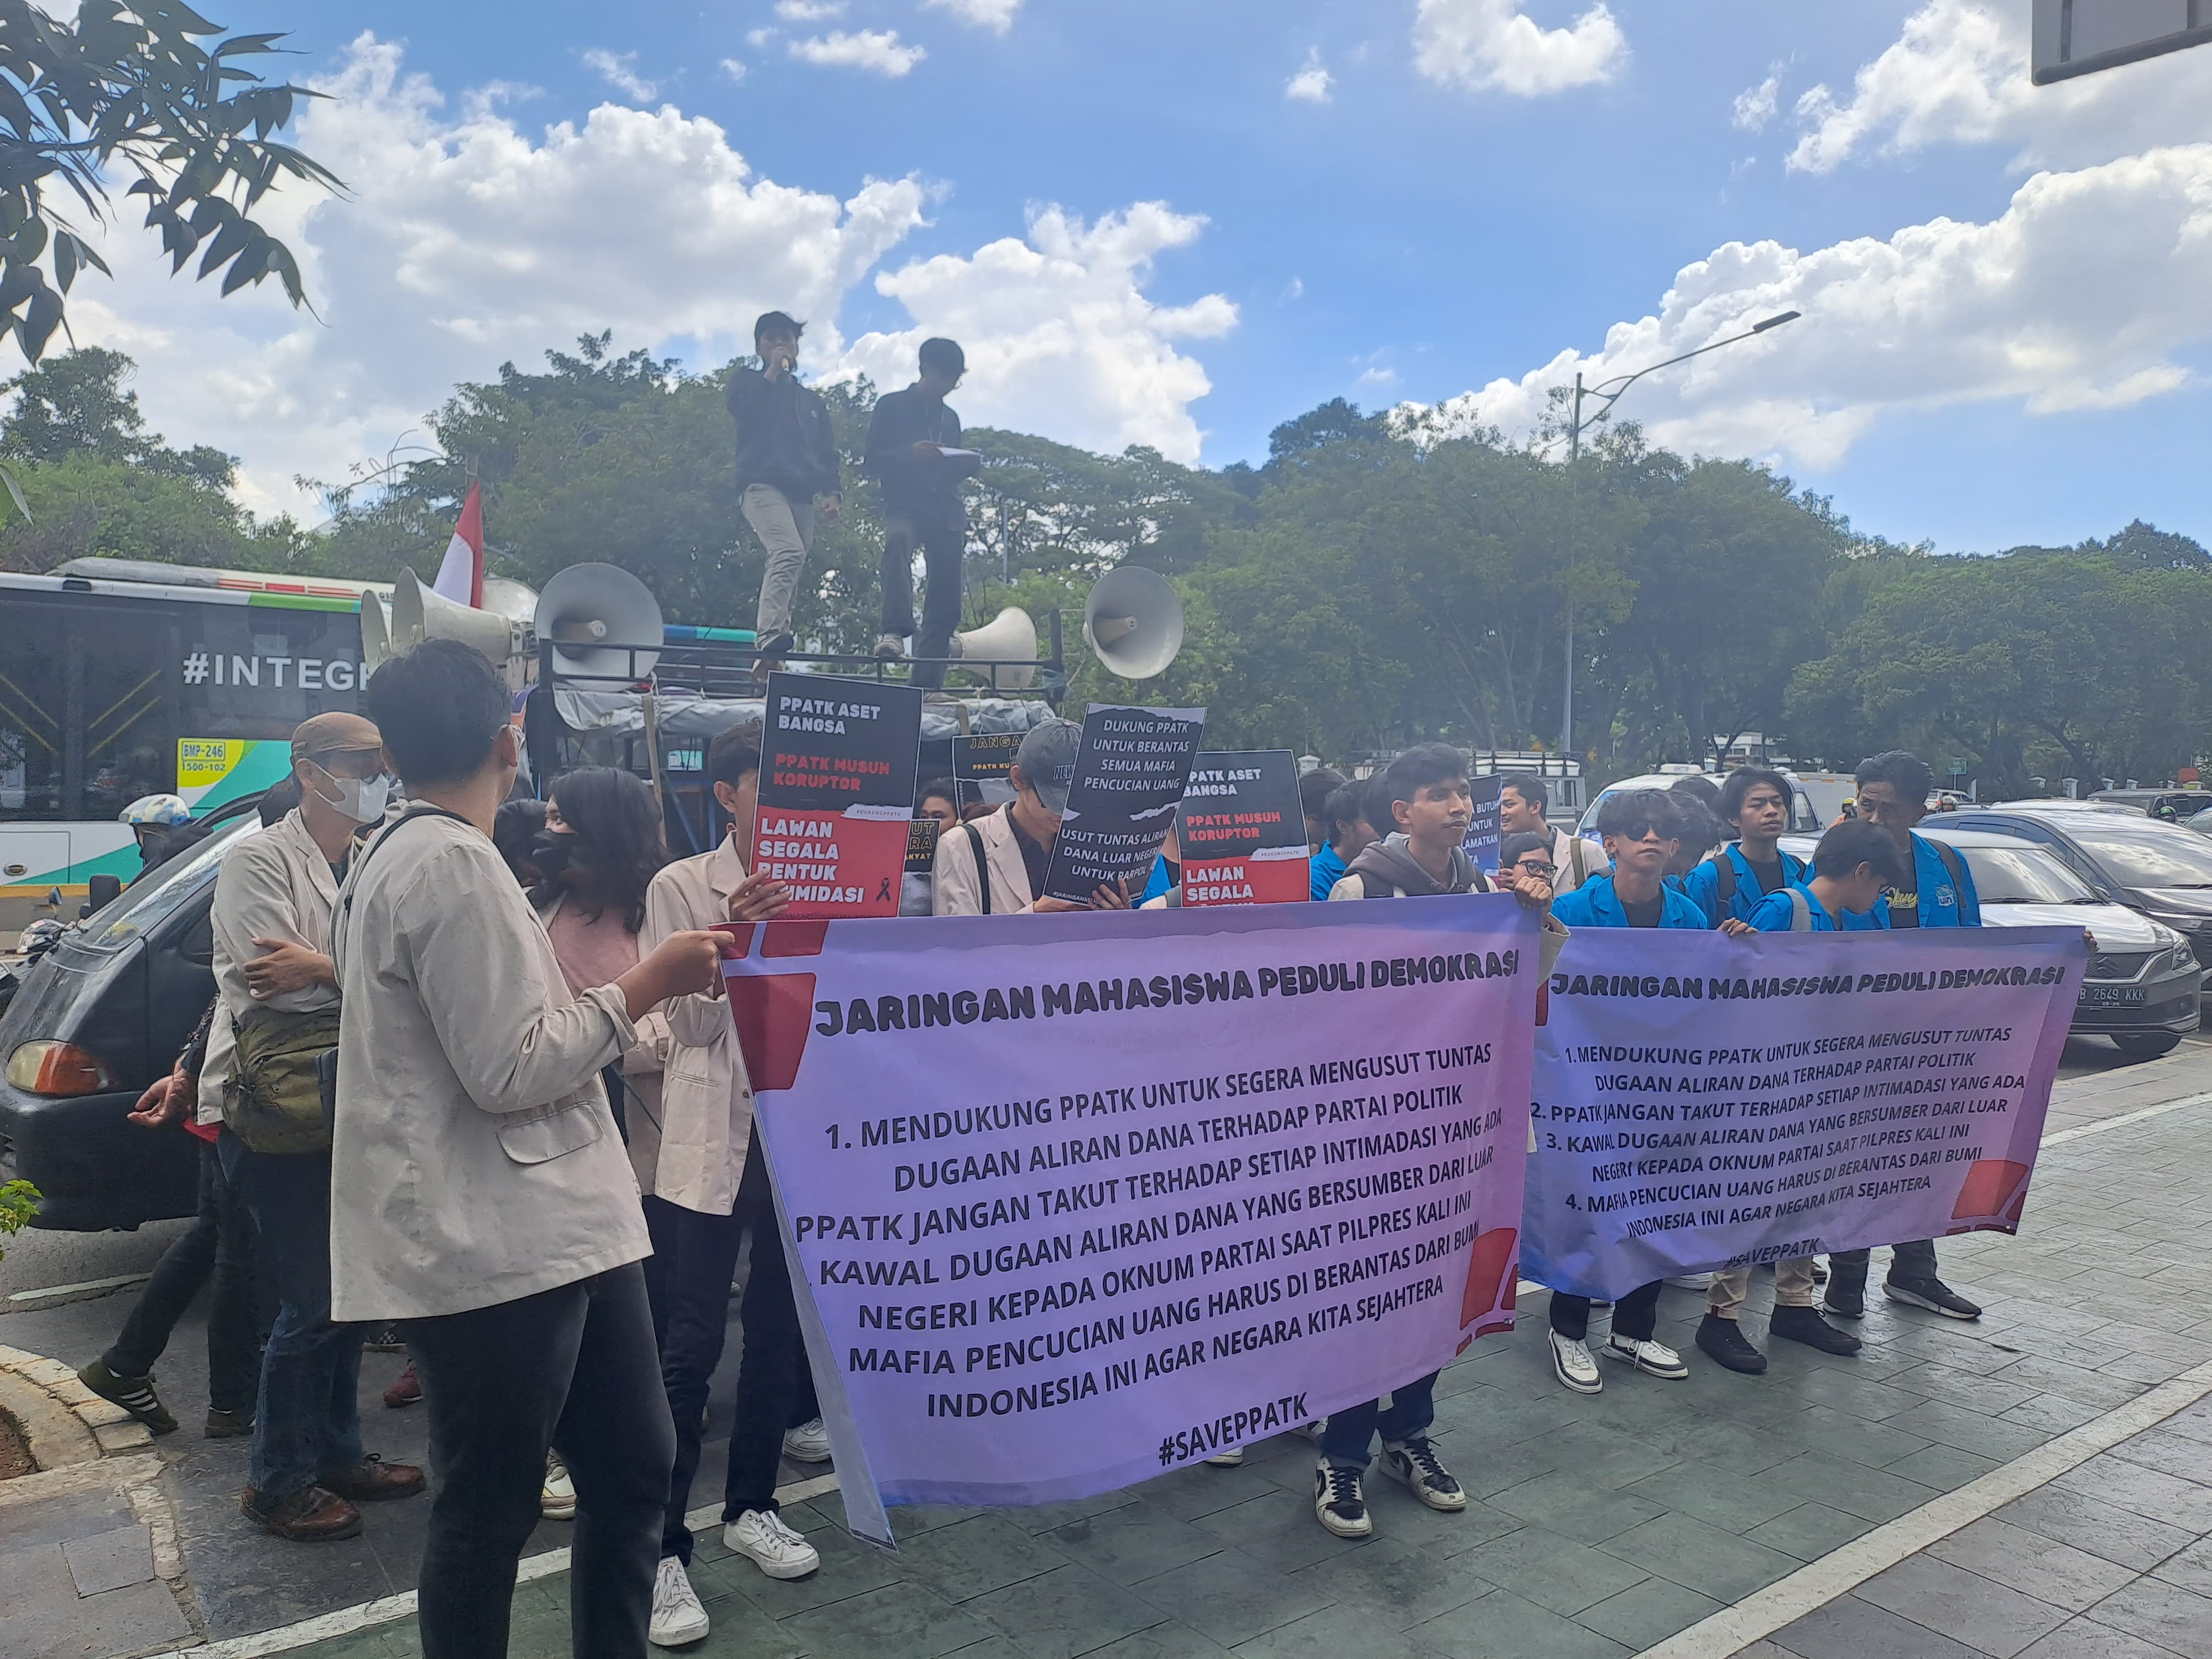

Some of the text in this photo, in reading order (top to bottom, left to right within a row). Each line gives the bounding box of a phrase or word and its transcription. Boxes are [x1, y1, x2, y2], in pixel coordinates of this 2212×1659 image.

[780, 696, 880, 719] PPATK ASET
[778, 714, 847, 735] BANGSA
[1103, 719, 1190, 734] DUKUNG PPATK
[185, 745, 223, 757] BMP-246
[1093, 738, 1190, 753] UNTUK BERANTAS
[775, 753, 830, 770] PPATK
[1100, 759, 1175, 772] SEMUA MAFIA
[773, 772, 861, 791] KORUPTOR
[1083, 776, 1181, 791] PENCUCIAN UANG
[1228, 769, 1261, 781] ASET
[760, 817, 833, 838] LAWAN
[1186, 812, 1281, 827] PPATK MUSUH
[1468, 818, 1493, 832] UNTUK
[1061, 827, 1170, 846] USUT TUNTAS ALIRAN
[1187, 827, 1261, 841] KORUPTOR
[758, 840, 839, 859] SEGALA
[1063, 846, 1099, 863] DANA
[1102, 852, 1131, 864] LUAR
[1071, 865, 1115, 882] UNTUK
[1187, 865, 1244, 883] LAWAN
[1186, 884, 1254, 901] SEGALA
[816, 950, 1519, 1036] JARINGAN MAHASISWA PEDULI DEMOKRASI
[1551, 966, 2065, 999] JARINGAN MAHASISWA PEDULI DEMOKRASI
[2079, 988, 2145, 1000] B 2649 KKK
[1578, 1027, 2012, 1065] MENDUKUNG PPATK UNTUK SEGERA MENGUSUT TUNTAS
[1595, 1052, 1977, 1093] DUGAAN ALIRAN DANA TERHADAP PARTAI POLITIK
[862, 1043, 1491, 1147] MENDUKUNG PPATK UNTUK SEGERA MENGUSUT TUNTAS
[1551, 1075, 2025, 1124] PPATK JANGAN TAKUT TERHADAP SETIAP INTIMADASI YANG ADA
[1567, 1098, 2008, 1153] KAWAL DUGAAN ALIRAN DANA YANG BERSUMBER DARI LUAR
[895, 1084, 1462, 1191] DUGAAN ALIRAN DANA TERHADAP PARTAI POLITIK
[1593, 1125, 1945, 1183] NEGERI KEPADA OKNUM PARTAI SAAT PILPRES KALI
[796, 1107, 1502, 1245] PPATK JANGAN TAKUT TERHADAP SETIAP INTIMADASI YANG ADA
[1588, 1147, 1982, 1213] MAFIA PENCUCIAN UANG HARUS BERANTAS DARI BUMI
[821, 1145, 1494, 1285] KAWAL DUGAAN ALIRAN DANA YANG BERSUMBER DARI LUAR
[1626, 1175, 1932, 1239] INDONESIA AGAR NEGARA KITA SEJAHTERA
[859, 1191, 1471, 1330] NEGERI KEPADA OKNUM PARTAI SAAT PILPRES KALI INI
[850, 1219, 1479, 1374] MAFIA PENCUCIAN UANG HARUS BERANTAS DARI BUMI
[928, 1275, 1443, 1417] INDONESIA INI AGAR NEGARA KITA SEJAHTERA
[1159, 1391, 1309, 1466] #SAVEPPATK
